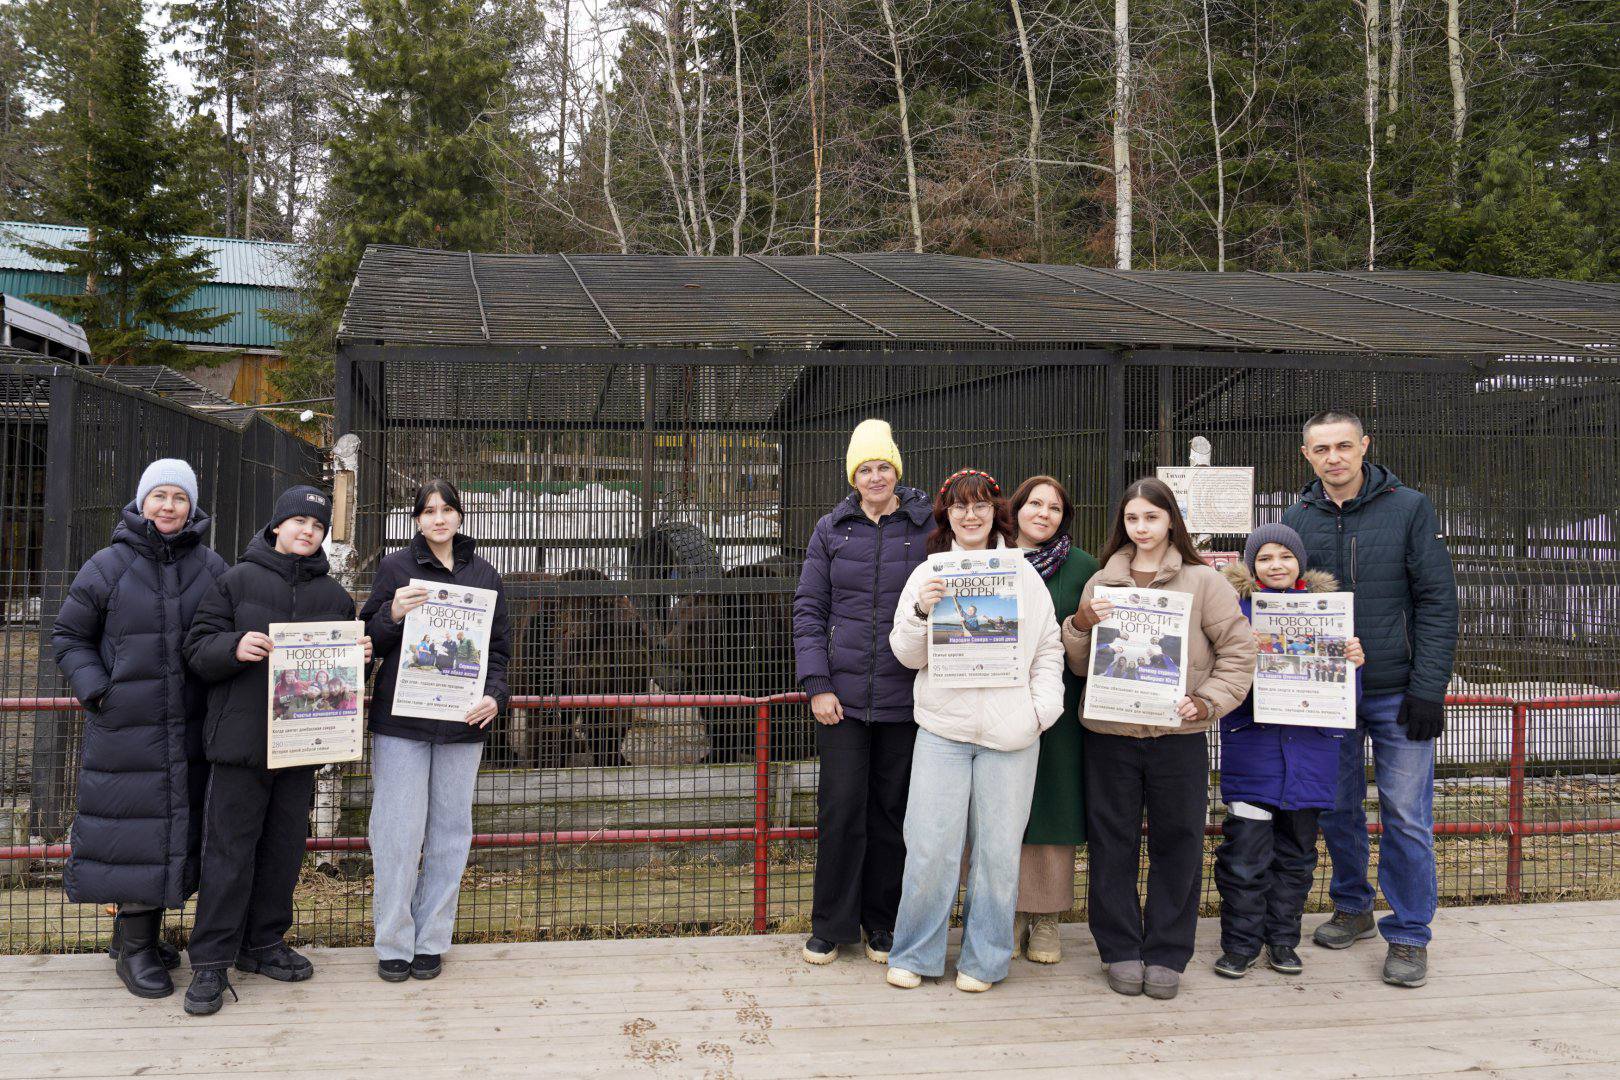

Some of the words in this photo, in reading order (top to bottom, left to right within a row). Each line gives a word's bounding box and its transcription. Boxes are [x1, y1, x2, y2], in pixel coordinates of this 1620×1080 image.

[946, 576, 1005, 587] НОВОСТИ
[956, 587, 995, 597] ЮГРЫ
[421, 604, 476, 621] НОВОСТИ
[1111, 610, 1171, 626] НОВОСТИ
[430, 616, 465, 630] ЮГРЫ
[1269, 616, 1334, 626] НОВОСТИ
[1121, 622, 1160, 636] ЮГРЫ
[1280, 627, 1323, 636] ЮГРЫ
[286, 648, 346, 659] НОВОСТИ
[297, 660, 336, 670] ЮГРЫ
